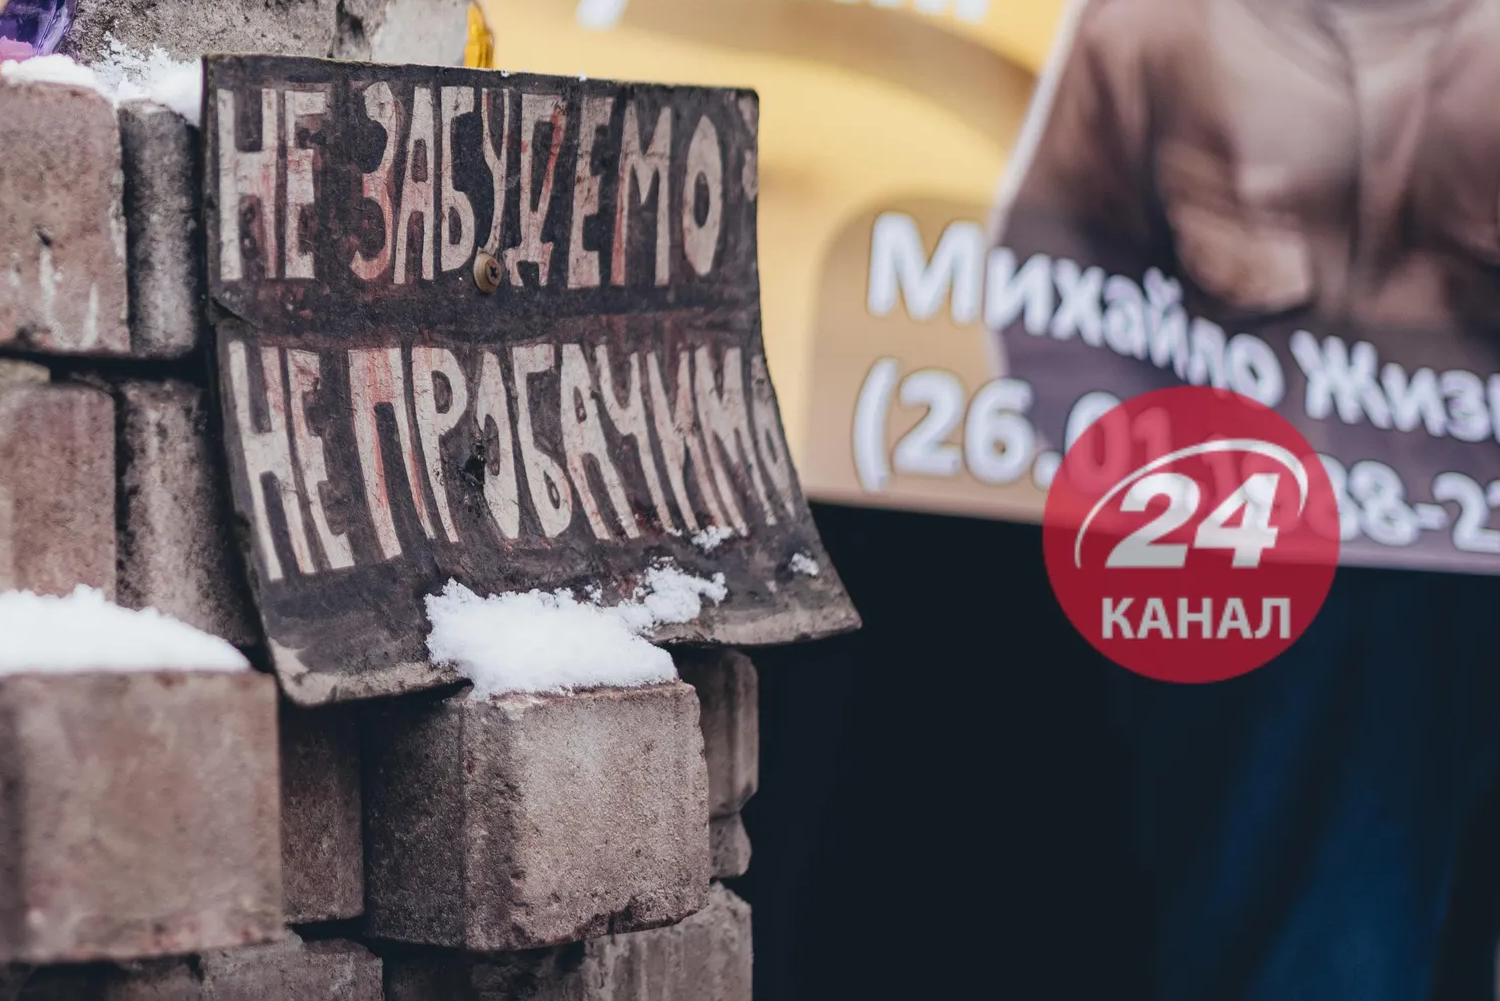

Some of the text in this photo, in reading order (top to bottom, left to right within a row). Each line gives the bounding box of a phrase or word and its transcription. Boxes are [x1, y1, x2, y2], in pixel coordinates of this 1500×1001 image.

[216, 81, 723, 289] НЕ ЗАБУДЕМО
[866, 211, 1500, 445] Михайло Жиз
[227, 340, 798, 581] НЕ ПРОБАЧИМО
